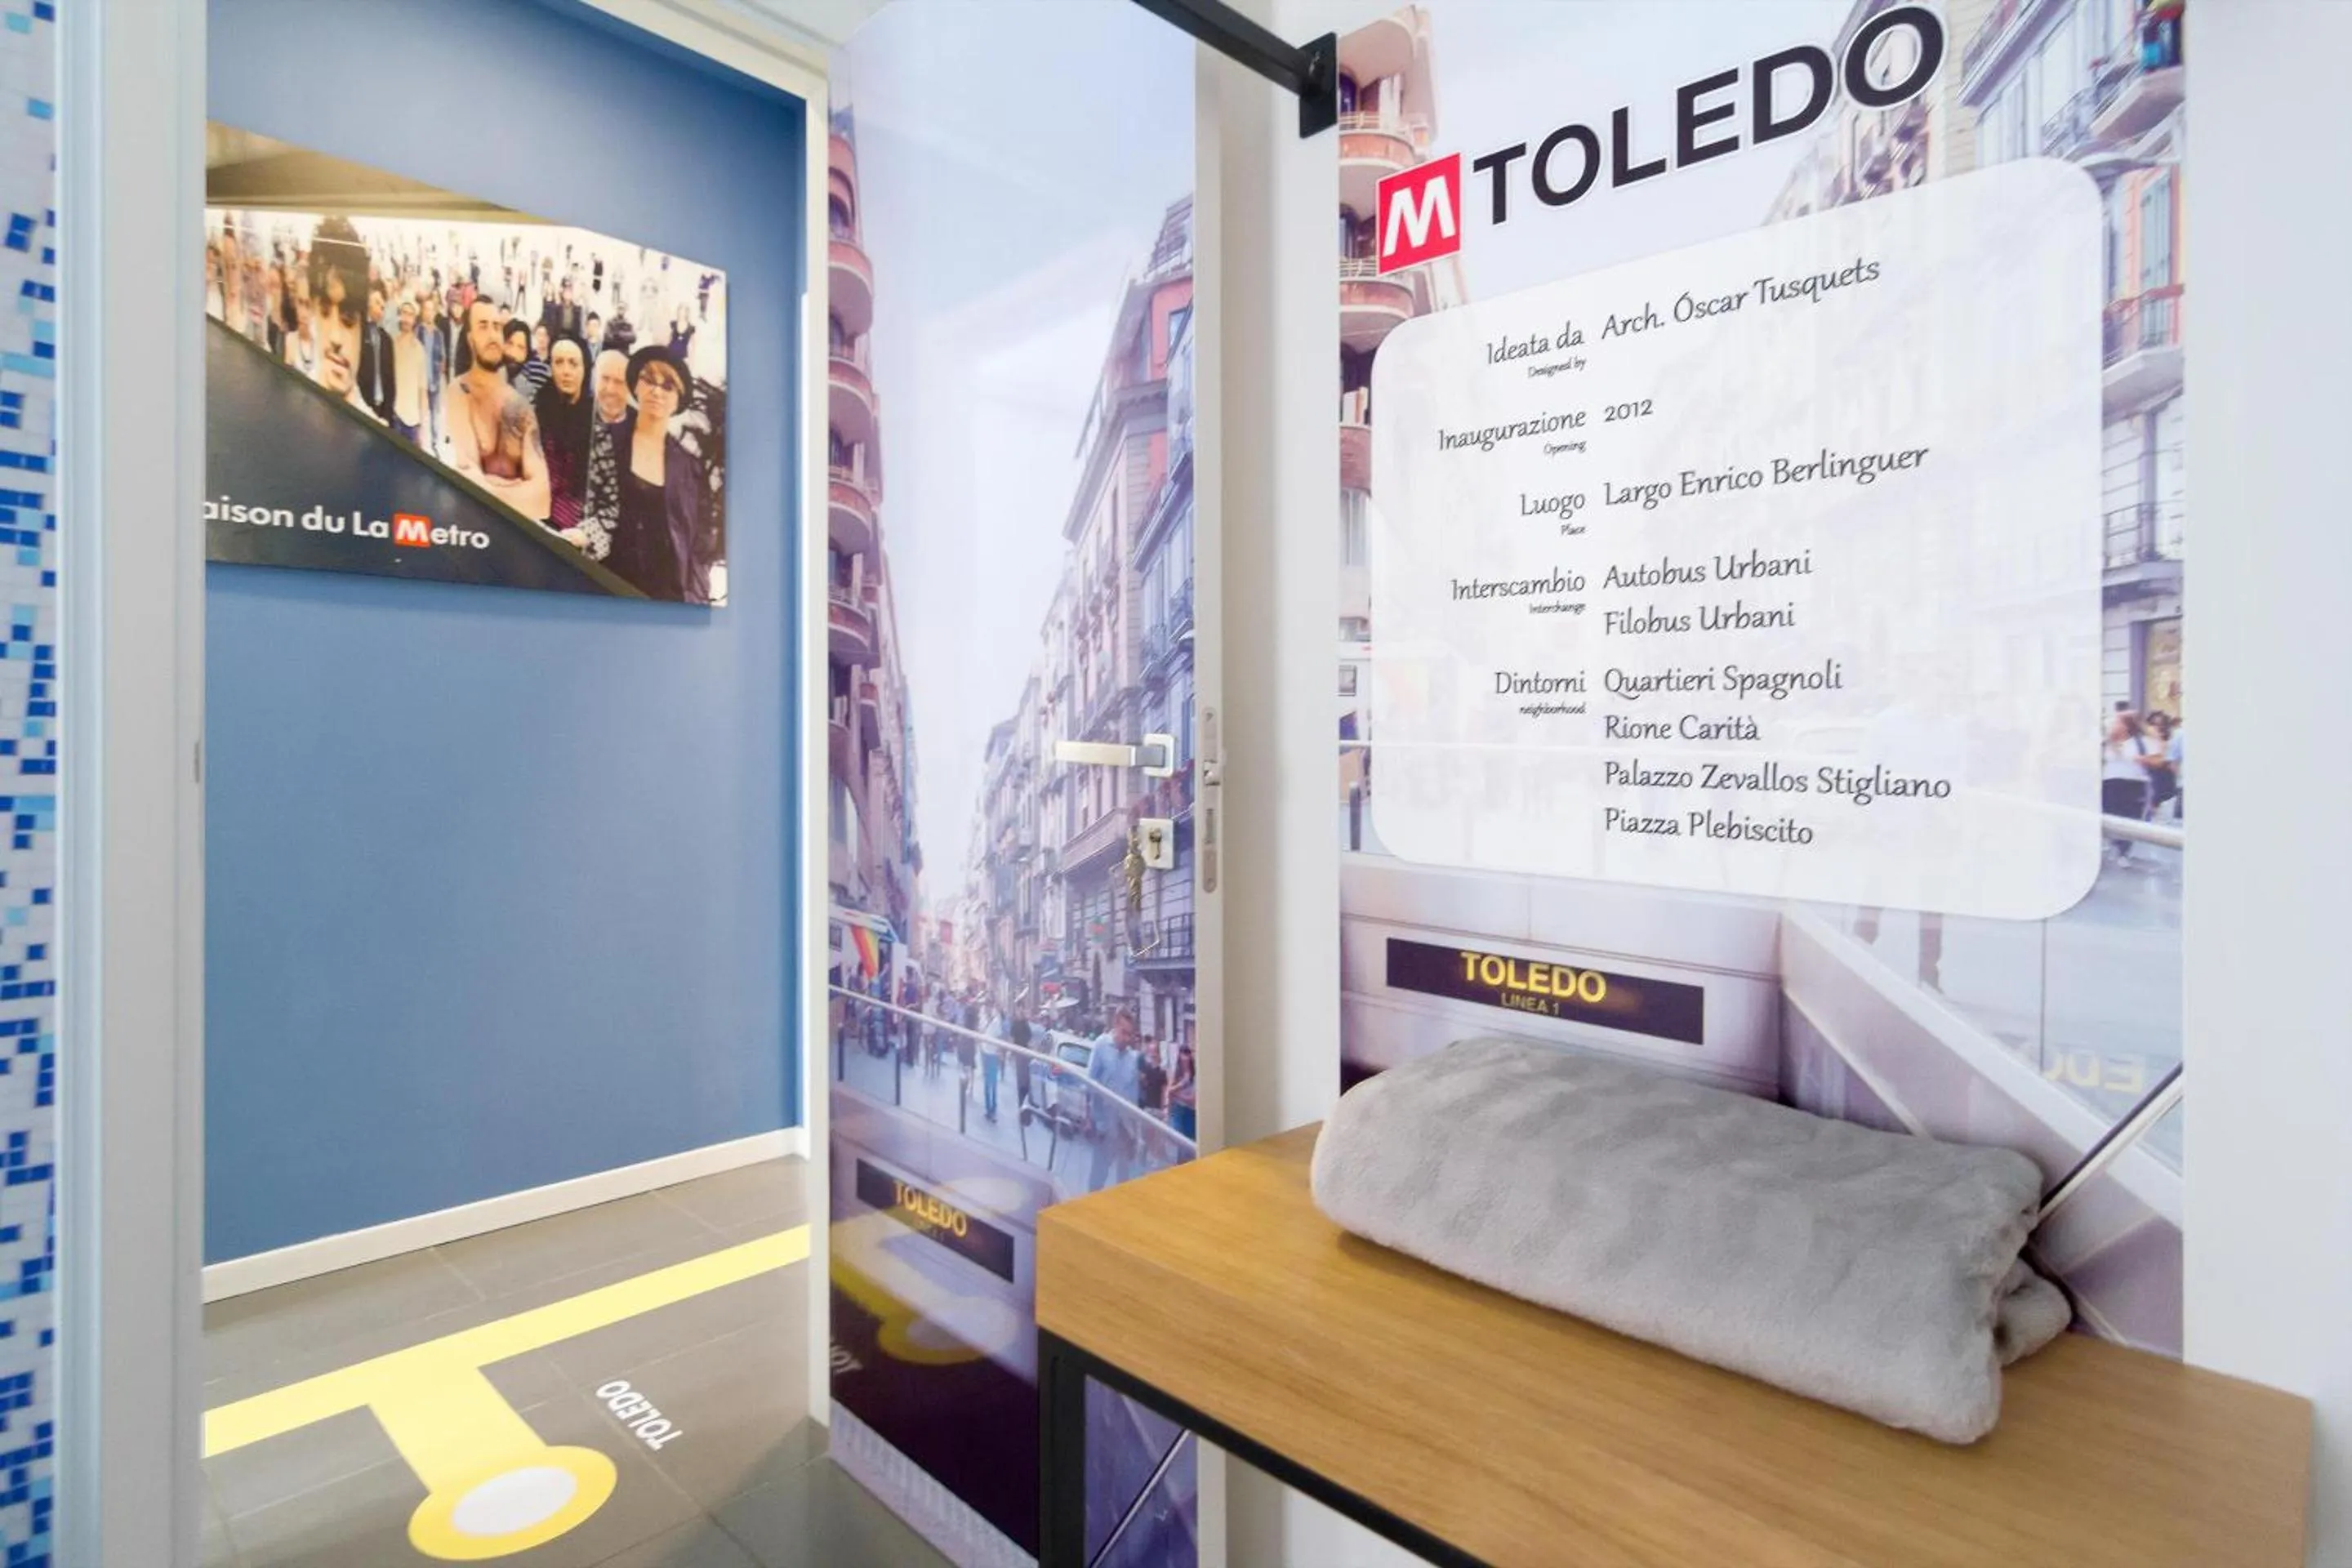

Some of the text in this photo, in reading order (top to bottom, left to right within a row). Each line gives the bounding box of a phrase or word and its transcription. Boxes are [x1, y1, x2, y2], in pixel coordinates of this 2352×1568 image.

[1473, 7, 1944, 225] TOLEDO
[1601, 257, 1880, 340] Arch. Óscar Tusquets
[1486, 319, 1585, 366] Ideata da
[1528, 355, 1587, 378] Designed by
[1438, 411, 1587, 452] Inaugurazione
[1604, 399, 1654, 423] 2012
[1543, 440, 1587, 457] Opening
[1603, 448, 1930, 510] Largo Enrico Berlinguer
[1520, 493, 1586, 520] Luogo
[301, 505, 345, 533] du
[352, 511, 389, 538] La
[396, 519, 490, 550] Metro
[1561, 523, 1586, 536] Place
[1450, 566, 1586, 601] Interscambio
[1602, 548, 1813, 590] Autobus Urbani
[1603, 599, 1795, 636] Filobus Urbani
[1494, 670, 1587, 694] Dintorni
[1604, 657, 1843, 701] Quartieri Spagnoli
[1604, 714, 1762, 741] Rione Carità
[1604, 758, 1952, 806] Palazzo Zevallos Stigliano
[1604, 807, 1814, 845] Piazza Plebiscito
[1461, 951, 1606, 1003] TOLEDO
[1500, 992, 1560, 1017] LINEA 1
[893, 1179, 967, 1236] TOLEDO
[595, 1379, 684, 1450] TOLEDO
